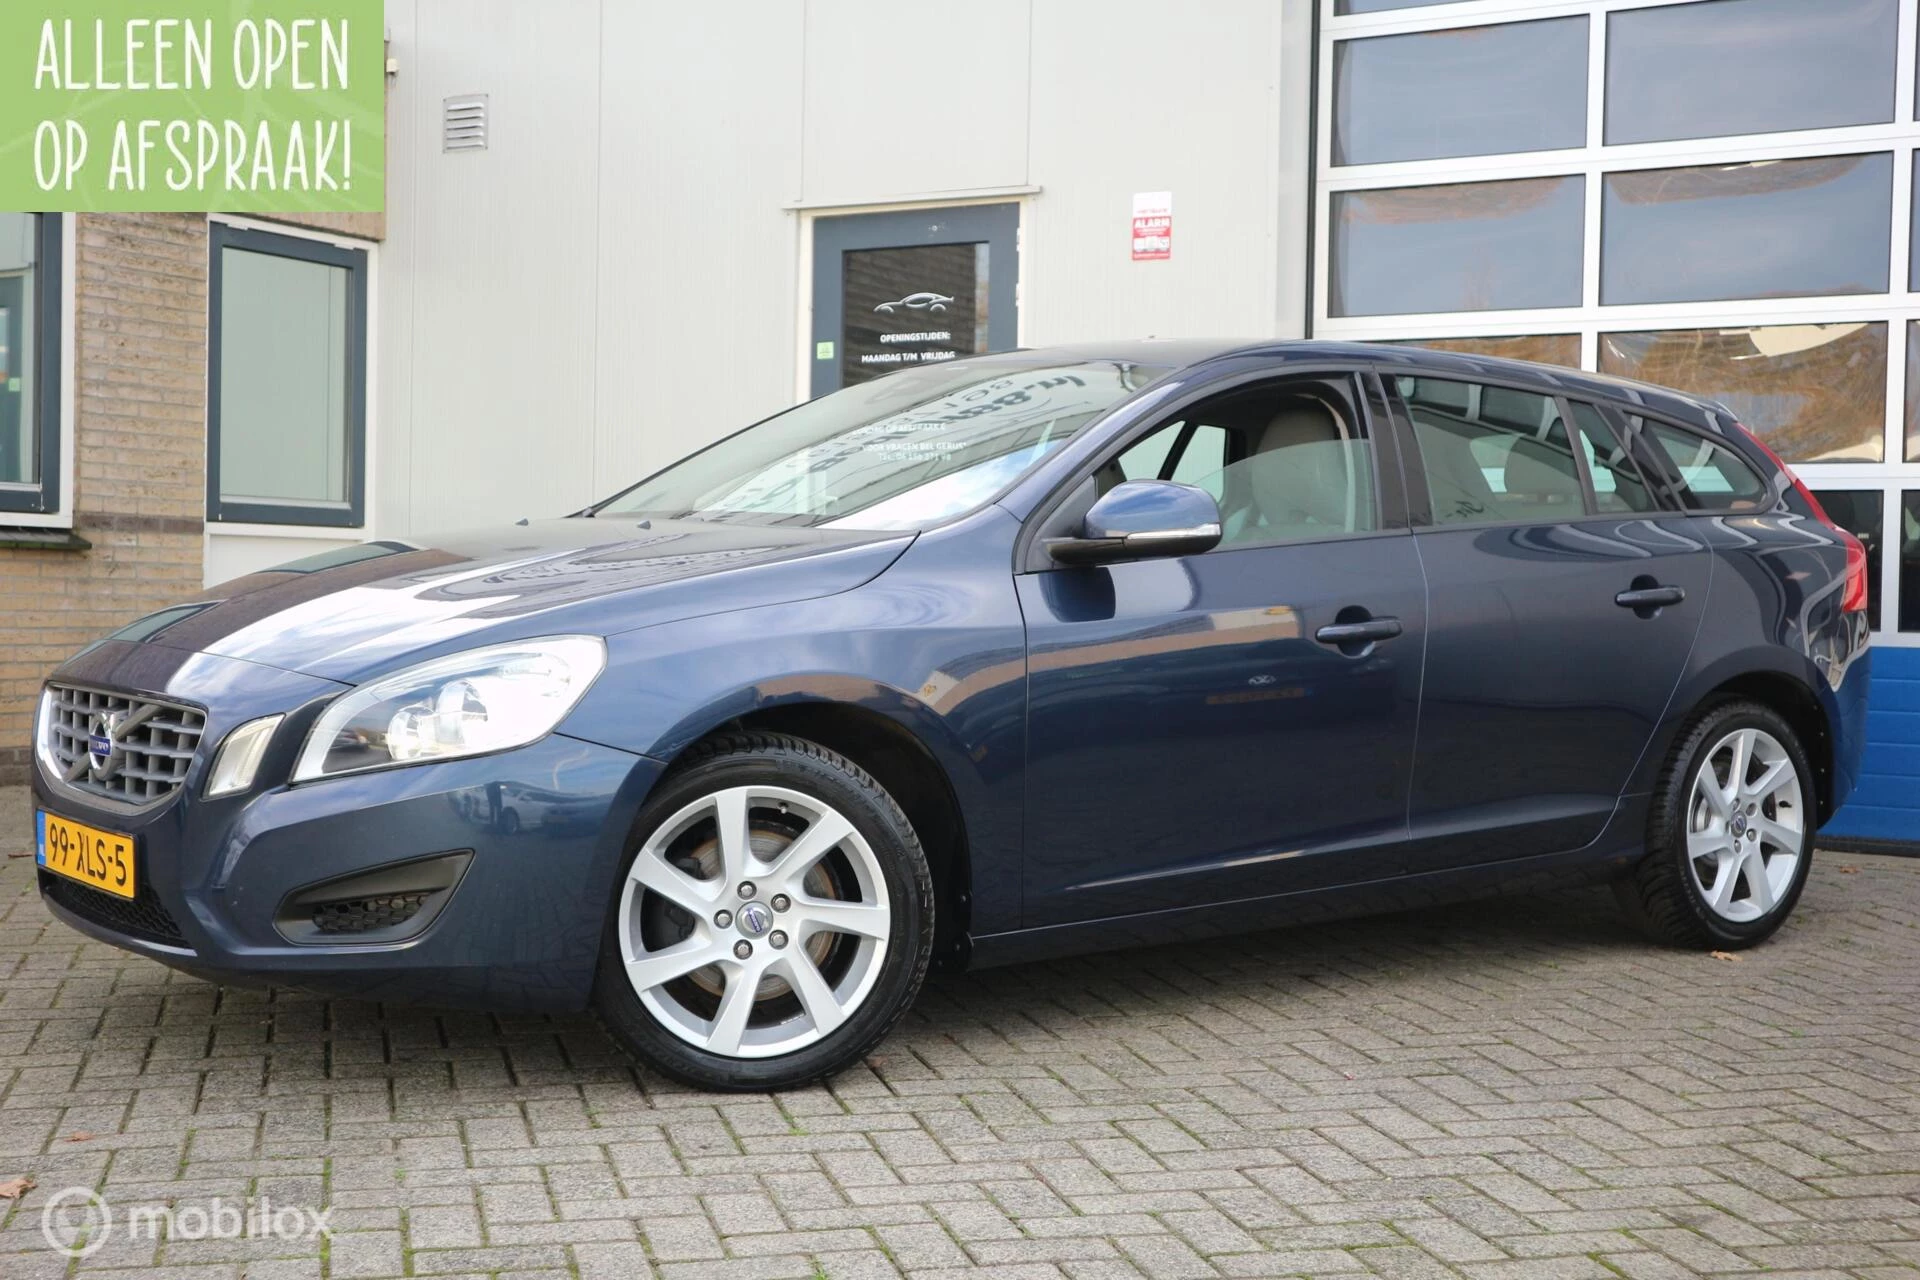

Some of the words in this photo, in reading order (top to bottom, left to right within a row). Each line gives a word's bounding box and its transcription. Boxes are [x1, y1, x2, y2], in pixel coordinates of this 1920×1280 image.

[1135, 218, 1170, 228] ALARM
[880, 331, 951, 343] OPENINGSTIJDEN:
[861, 353, 901, 363] MAANDAG
[902, 352, 918, 361] T/M
[920, 351, 956, 361] VRIJDAG
[50, 823, 127, 887] 99-XLS-5
